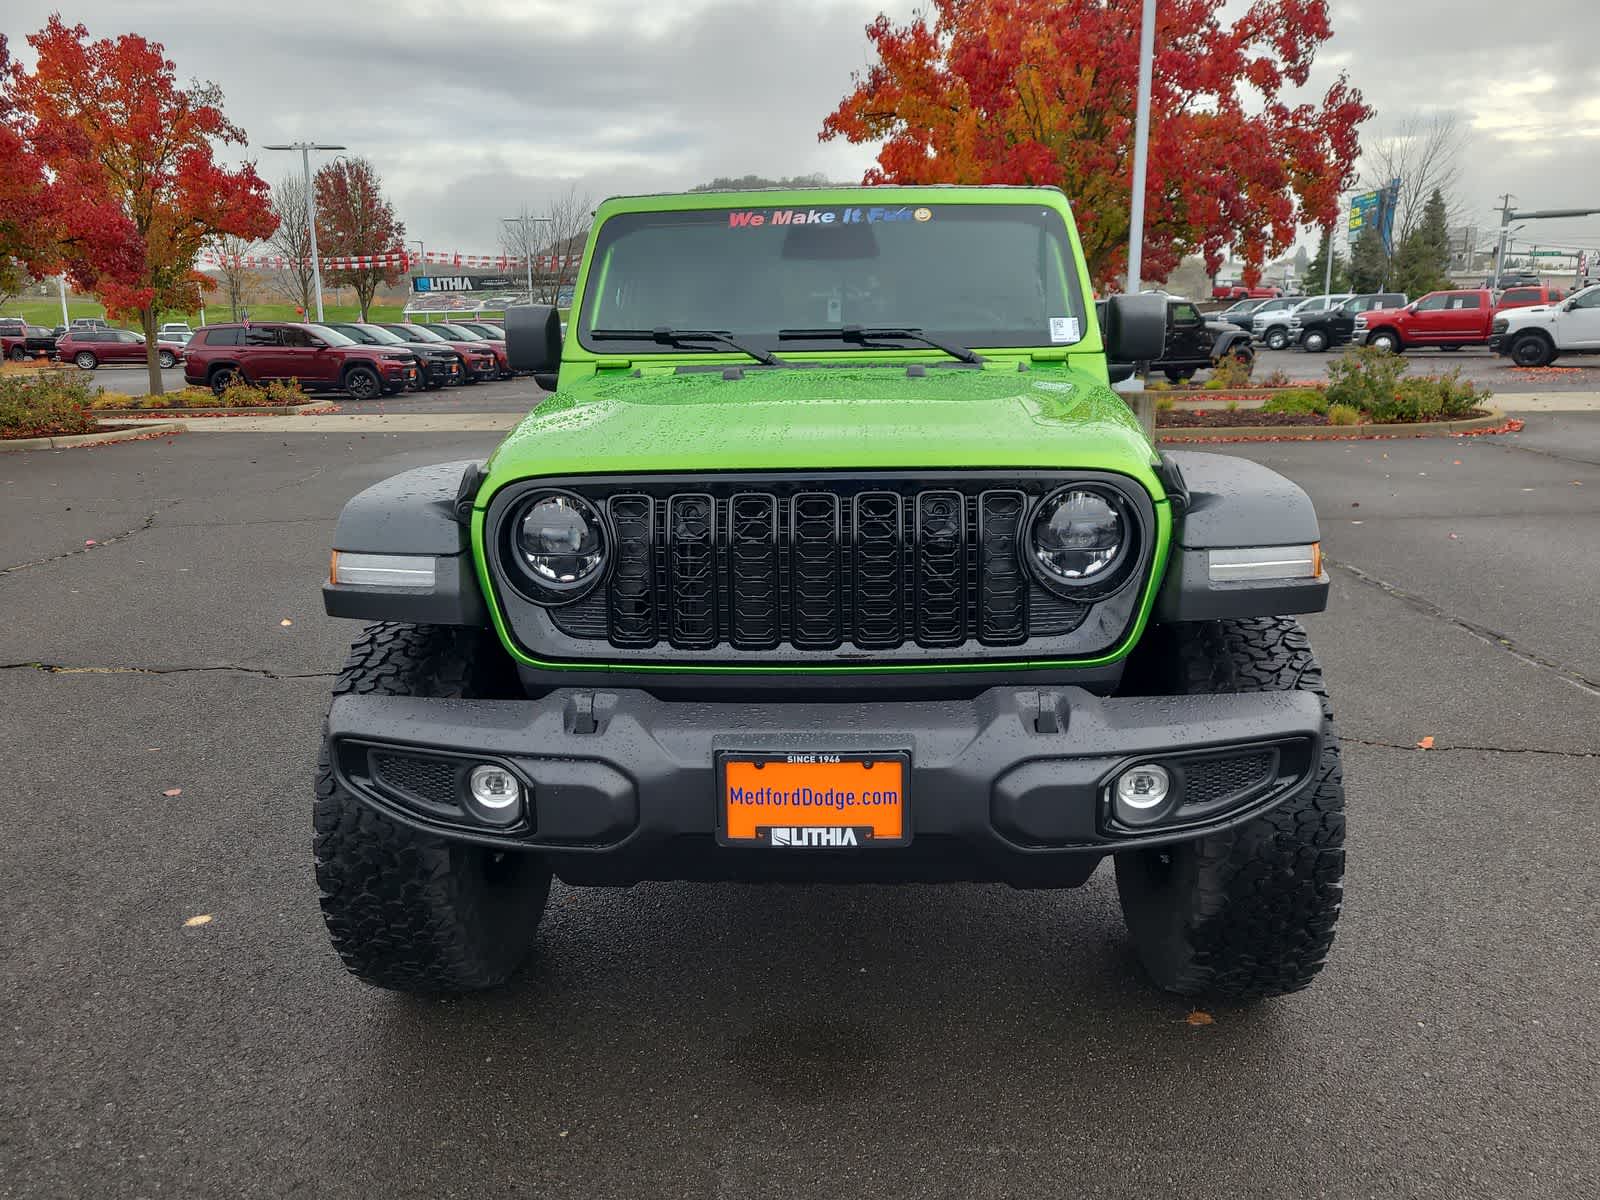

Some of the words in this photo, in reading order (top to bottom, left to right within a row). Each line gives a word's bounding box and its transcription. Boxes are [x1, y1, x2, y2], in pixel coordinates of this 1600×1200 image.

[728, 211, 765, 228] We
[771, 208, 836, 225] Make
[842, 207, 862, 224] It
[429, 277, 473, 292] LITHIA
[787, 755, 816, 763] SINCE
[818, 755, 841, 763] 1946
[729, 786, 898, 810] MedfordDodge.com
[791, 827, 858, 846] LITHIA
